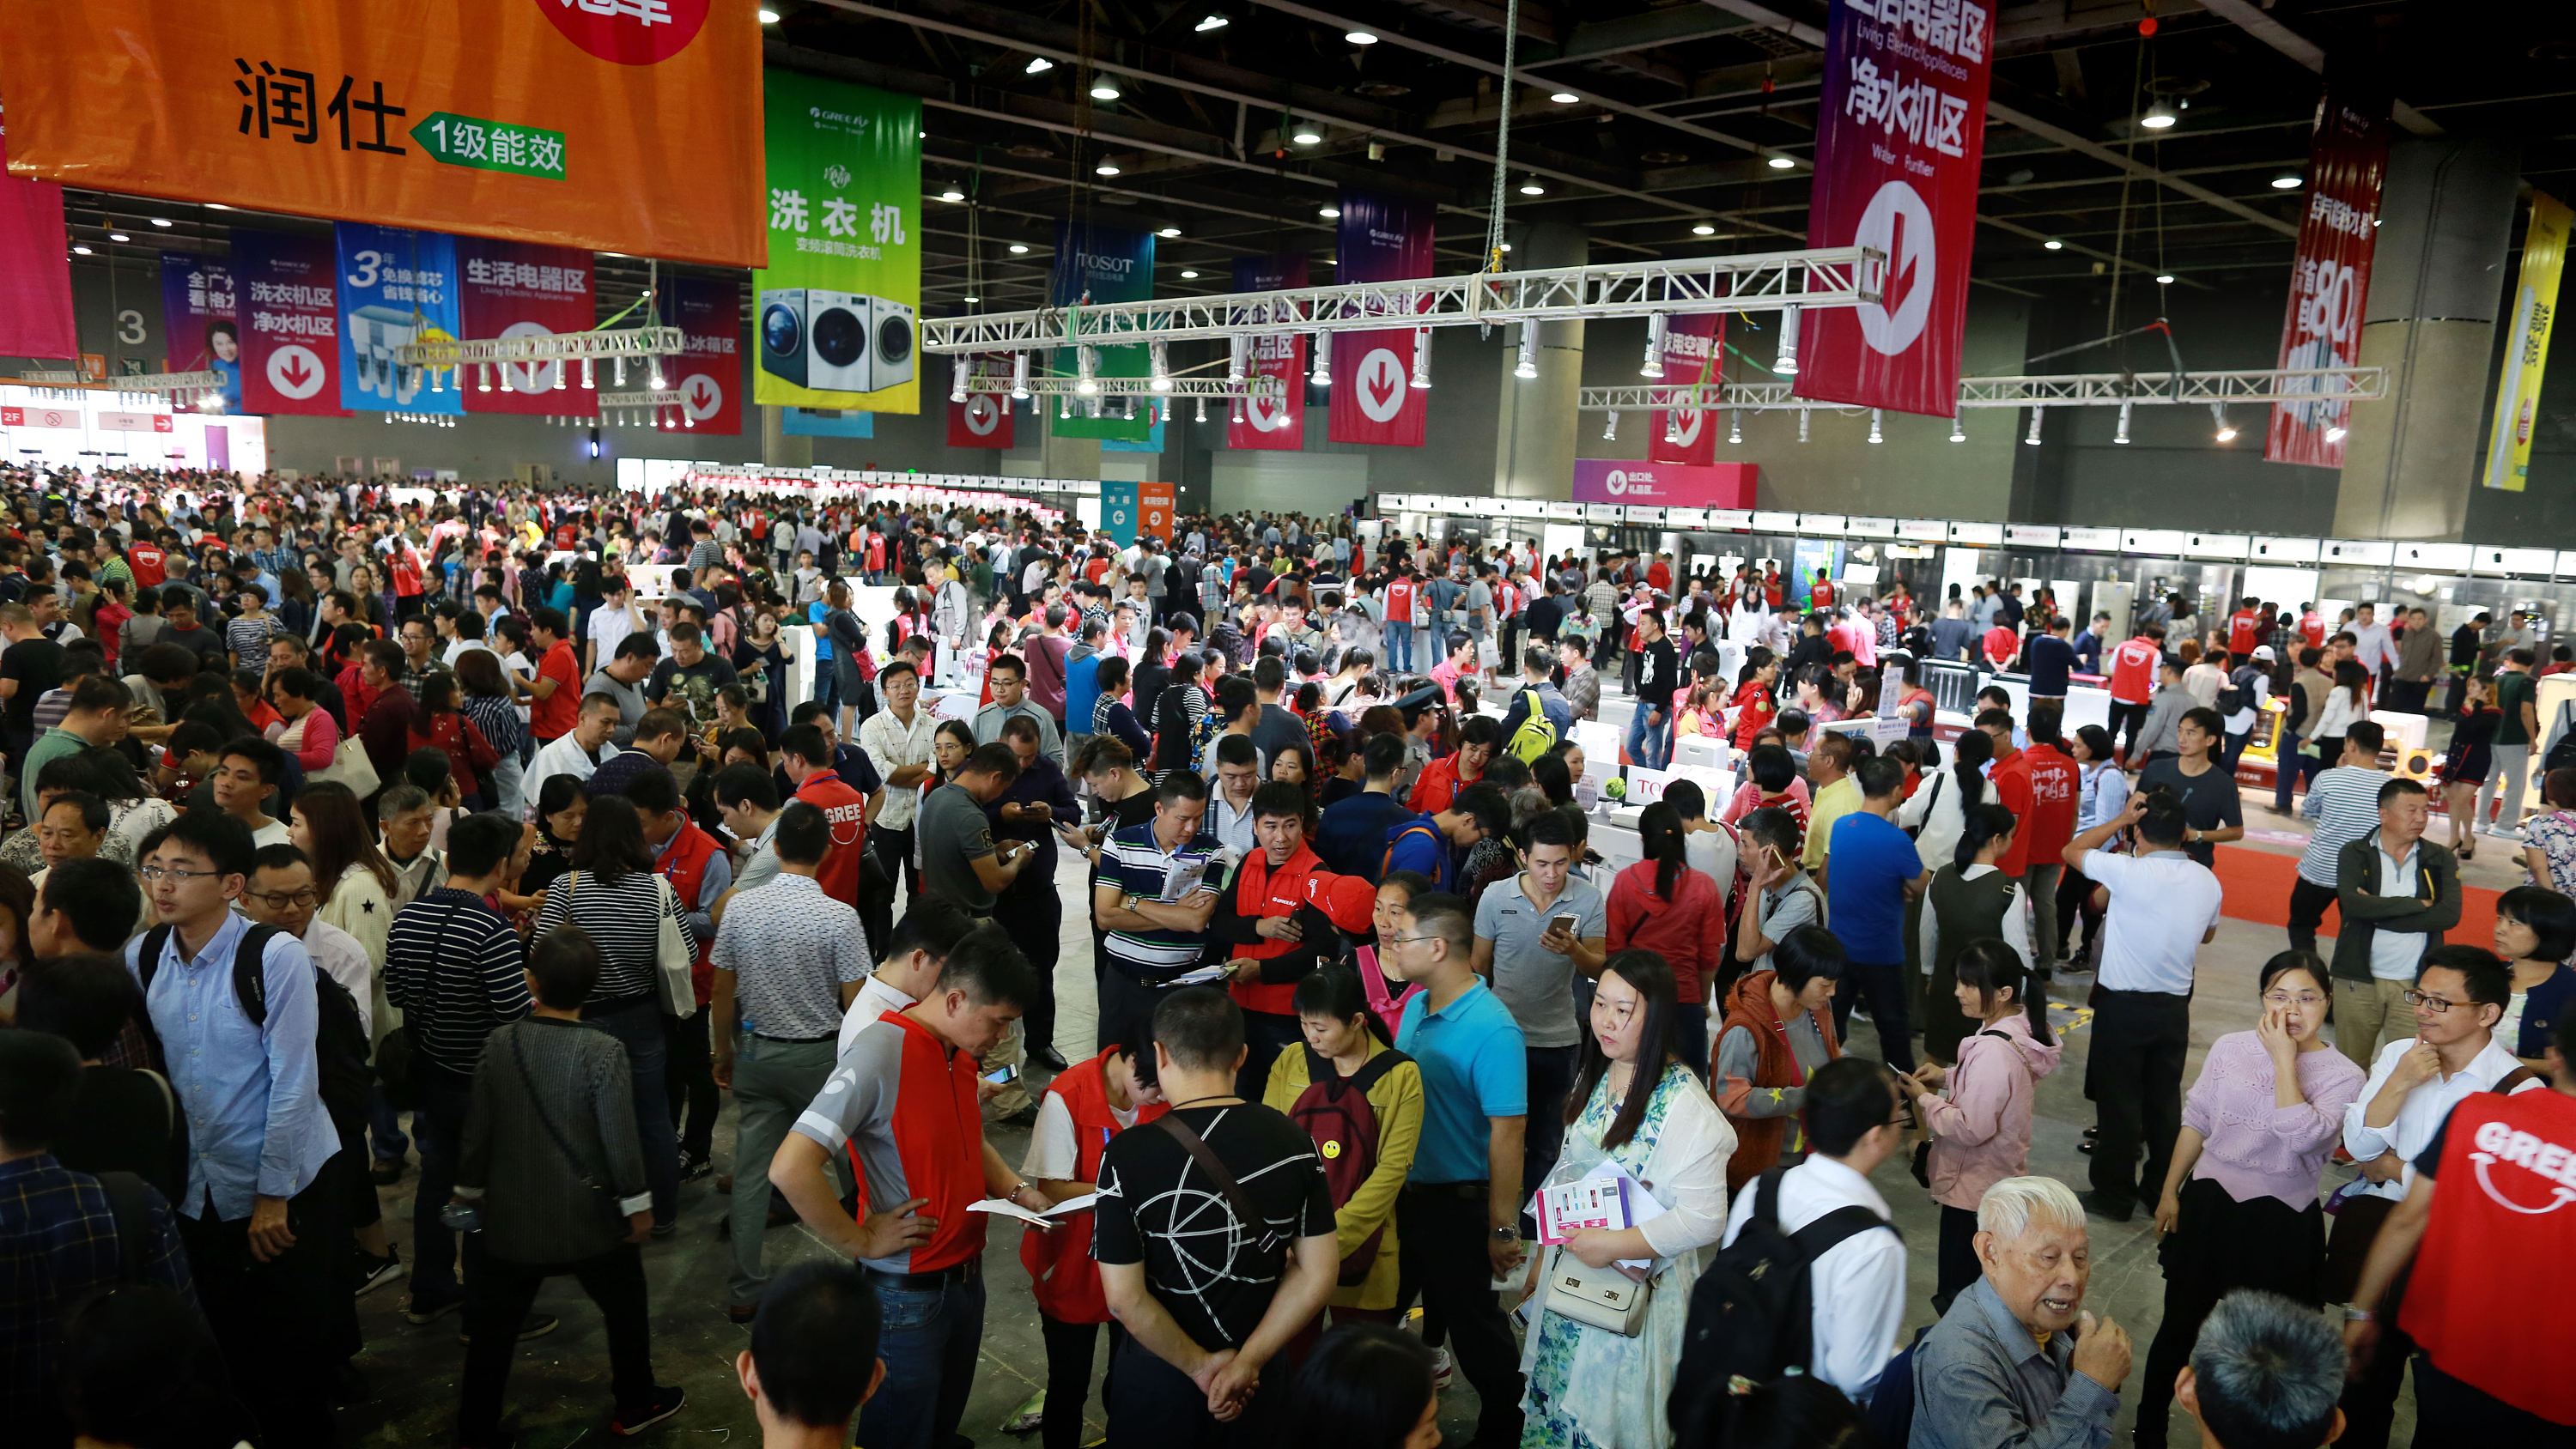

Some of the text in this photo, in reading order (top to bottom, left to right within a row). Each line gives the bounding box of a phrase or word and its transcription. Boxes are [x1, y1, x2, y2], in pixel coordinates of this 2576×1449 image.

[1857, 19, 1883, 50] Living
[233, 58, 406, 156] 润仕
[1845, 57, 1968, 159] 净水机区
[432, 119, 563, 173] 1级能效
[1872, 142, 1935, 177] Water Purifier
[770, 187, 905, 246] 洗衣机
[348, 250, 382, 288] 3
[467, 258, 586, 294] 生活电器区
[1077, 252, 1133, 274] TOSOT
[251, 281, 334, 307] 洗衣机区
[118, 310, 147, 343] 3
[252, 311, 336, 336] 净水机区
[683, 334, 737, 354] 冰箱区
[3, 412, 21, 422] 2F
[1637, 779, 1662, 797] TO
[824, 803, 861, 824] GREE
[2475, 1121, 2576, 1191] GREE
